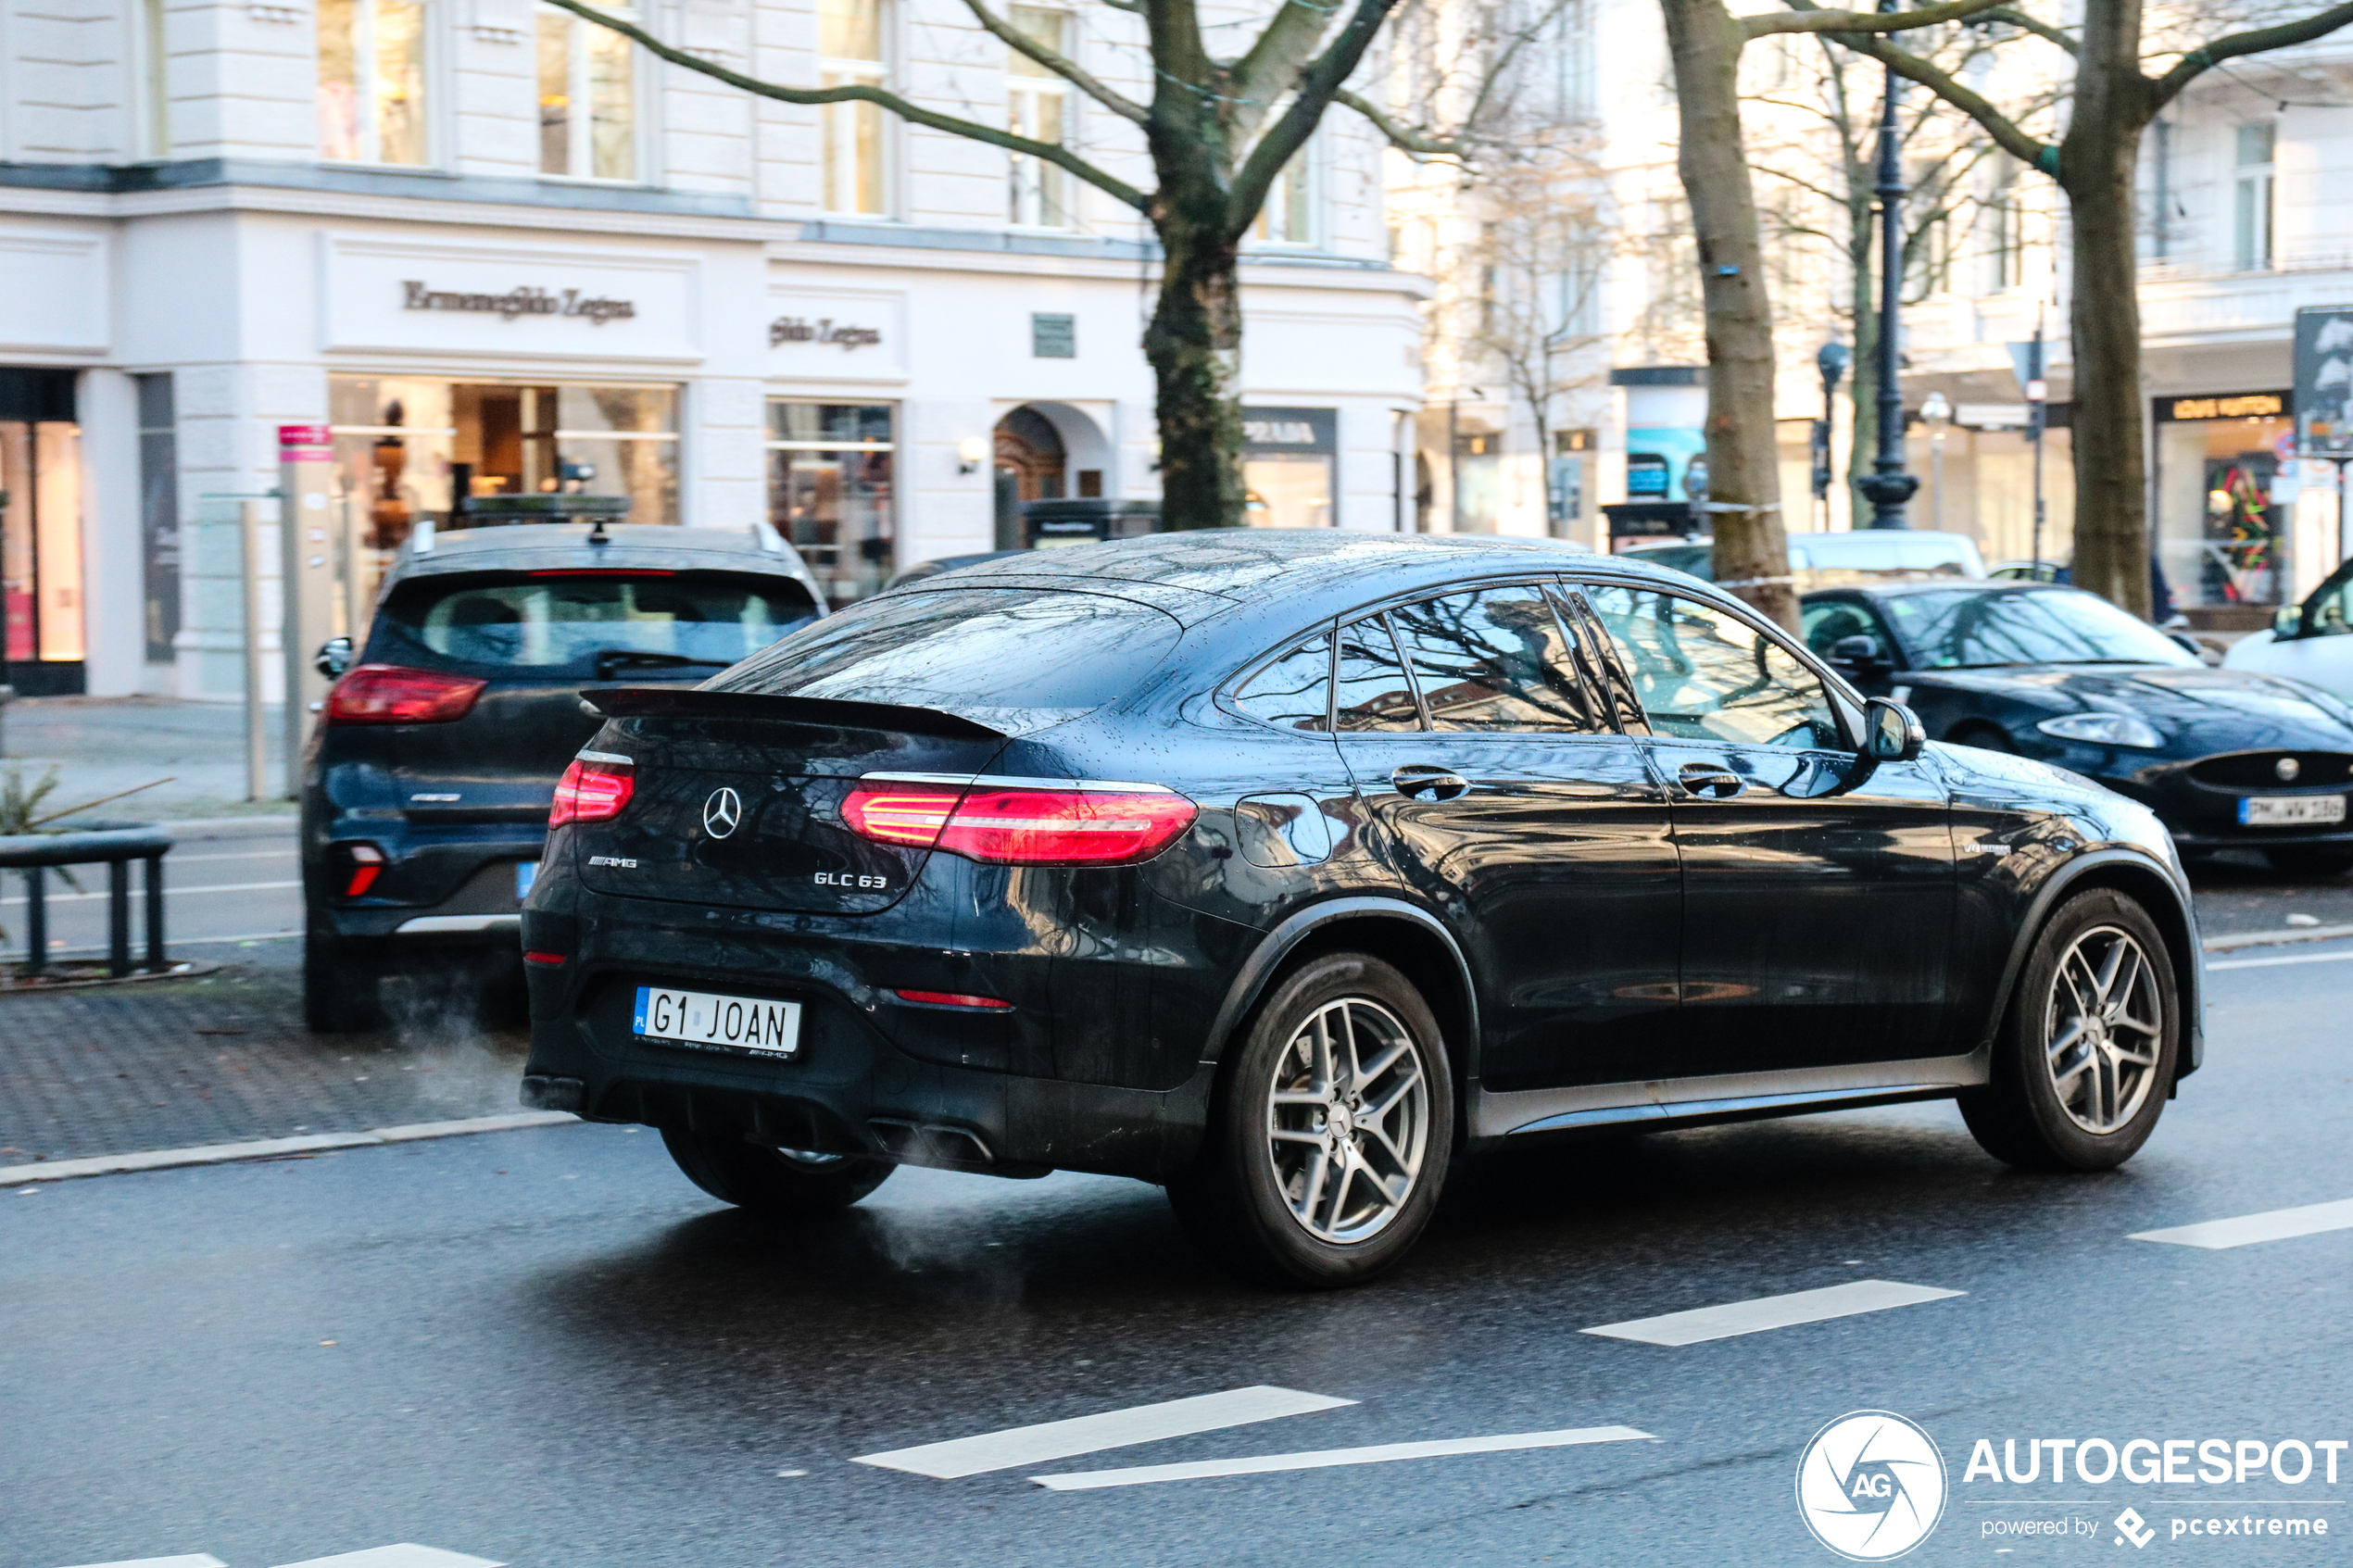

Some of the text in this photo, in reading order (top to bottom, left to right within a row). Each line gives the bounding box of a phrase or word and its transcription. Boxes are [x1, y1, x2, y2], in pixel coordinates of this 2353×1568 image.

[562, 288, 635, 325] Zegna
[817, 318, 882, 352] Zegna
[603, 857, 637, 869] AMG
[813, 872, 887, 889] GLC 63
[635, 1016, 645, 1028] PL
[654, 994, 786, 1047] G1 JOAN
[761, 1049, 788, 1060] AMG
